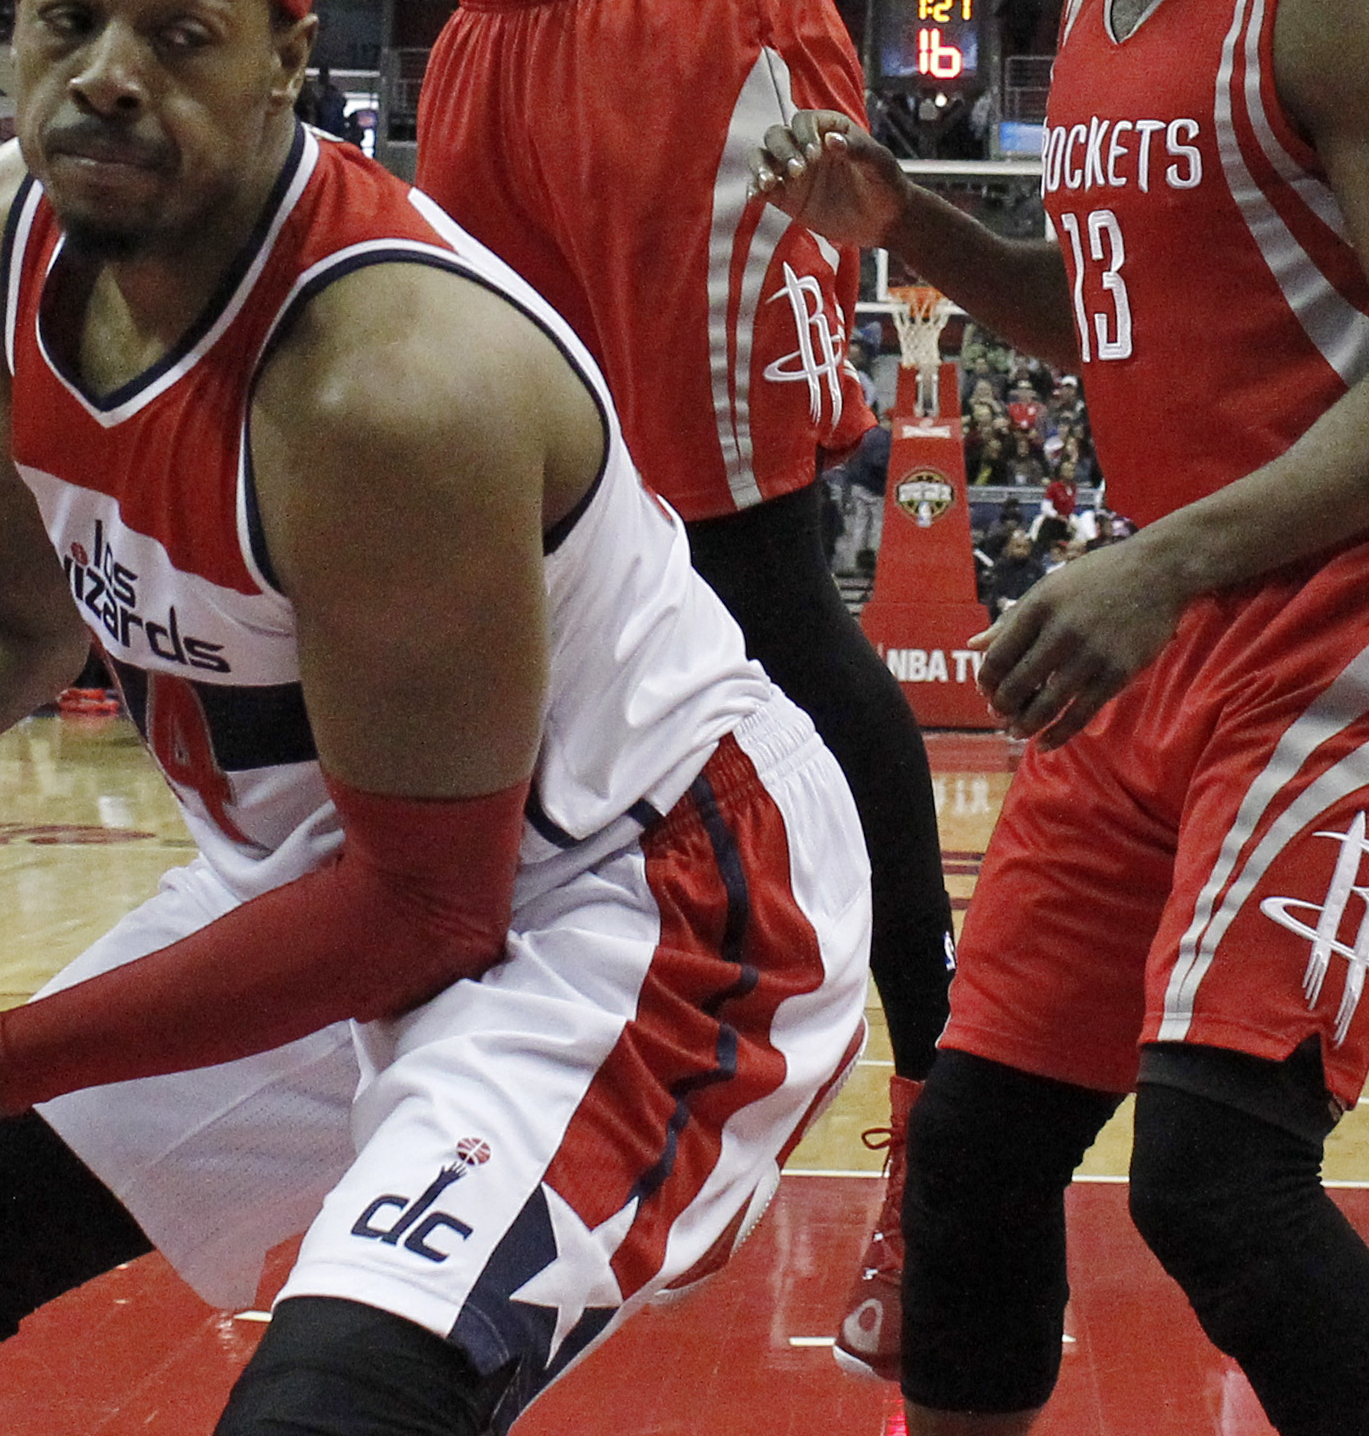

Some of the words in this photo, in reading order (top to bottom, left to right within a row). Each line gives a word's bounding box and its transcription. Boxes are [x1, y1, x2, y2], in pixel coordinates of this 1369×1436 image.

[917, 28, 963, 79] 16
[1061, 210, 1133, 363] 13
[886, 648, 949, 684] NBA
